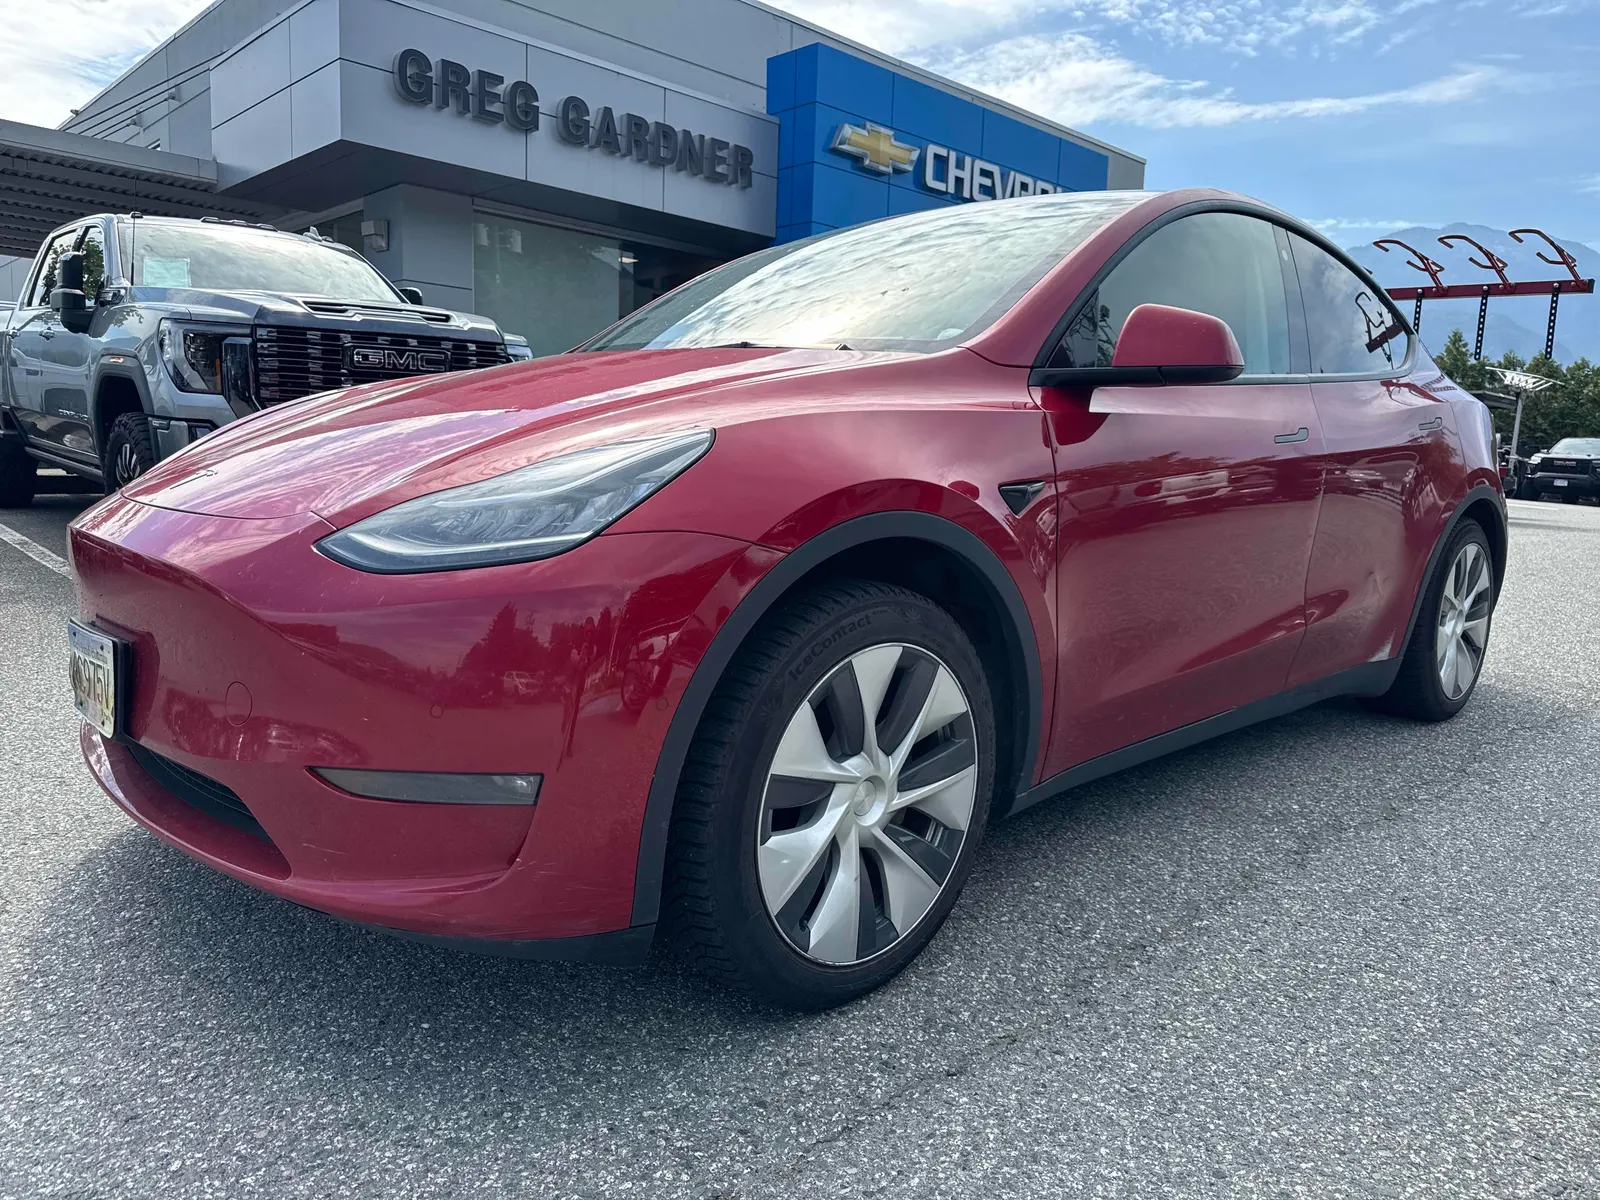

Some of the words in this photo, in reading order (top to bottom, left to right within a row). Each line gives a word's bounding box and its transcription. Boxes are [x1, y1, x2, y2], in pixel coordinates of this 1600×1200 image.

[393, 48, 539, 131] GREG
[556, 95, 754, 192] GARDNER
[925, 144, 1063, 202] CHEVR
[353, 349, 445, 372] GMC
[789, 614, 873, 681] IceContact
